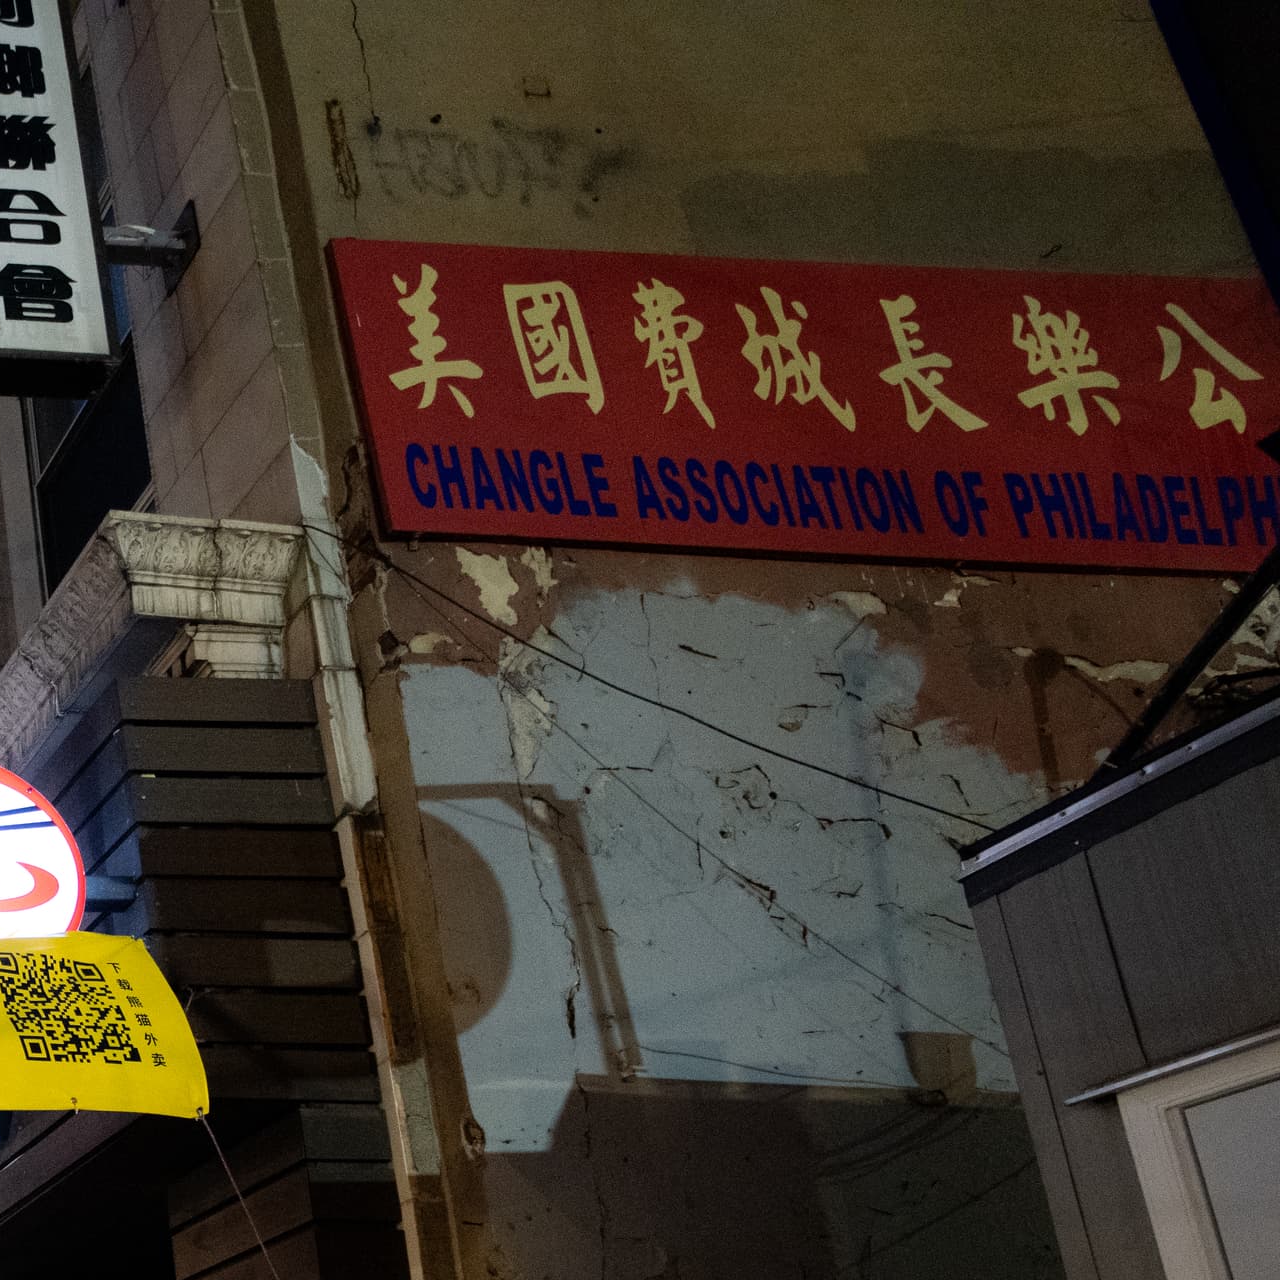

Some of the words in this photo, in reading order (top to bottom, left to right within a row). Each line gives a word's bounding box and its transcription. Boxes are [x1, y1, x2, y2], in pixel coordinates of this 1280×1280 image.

[389, 264, 1265, 436] 美國費城長樂公
[405, 442, 618, 518] CHANGLE
[633, 455, 925, 537] ASSOCIATION
[934, 469, 992, 537] OF
